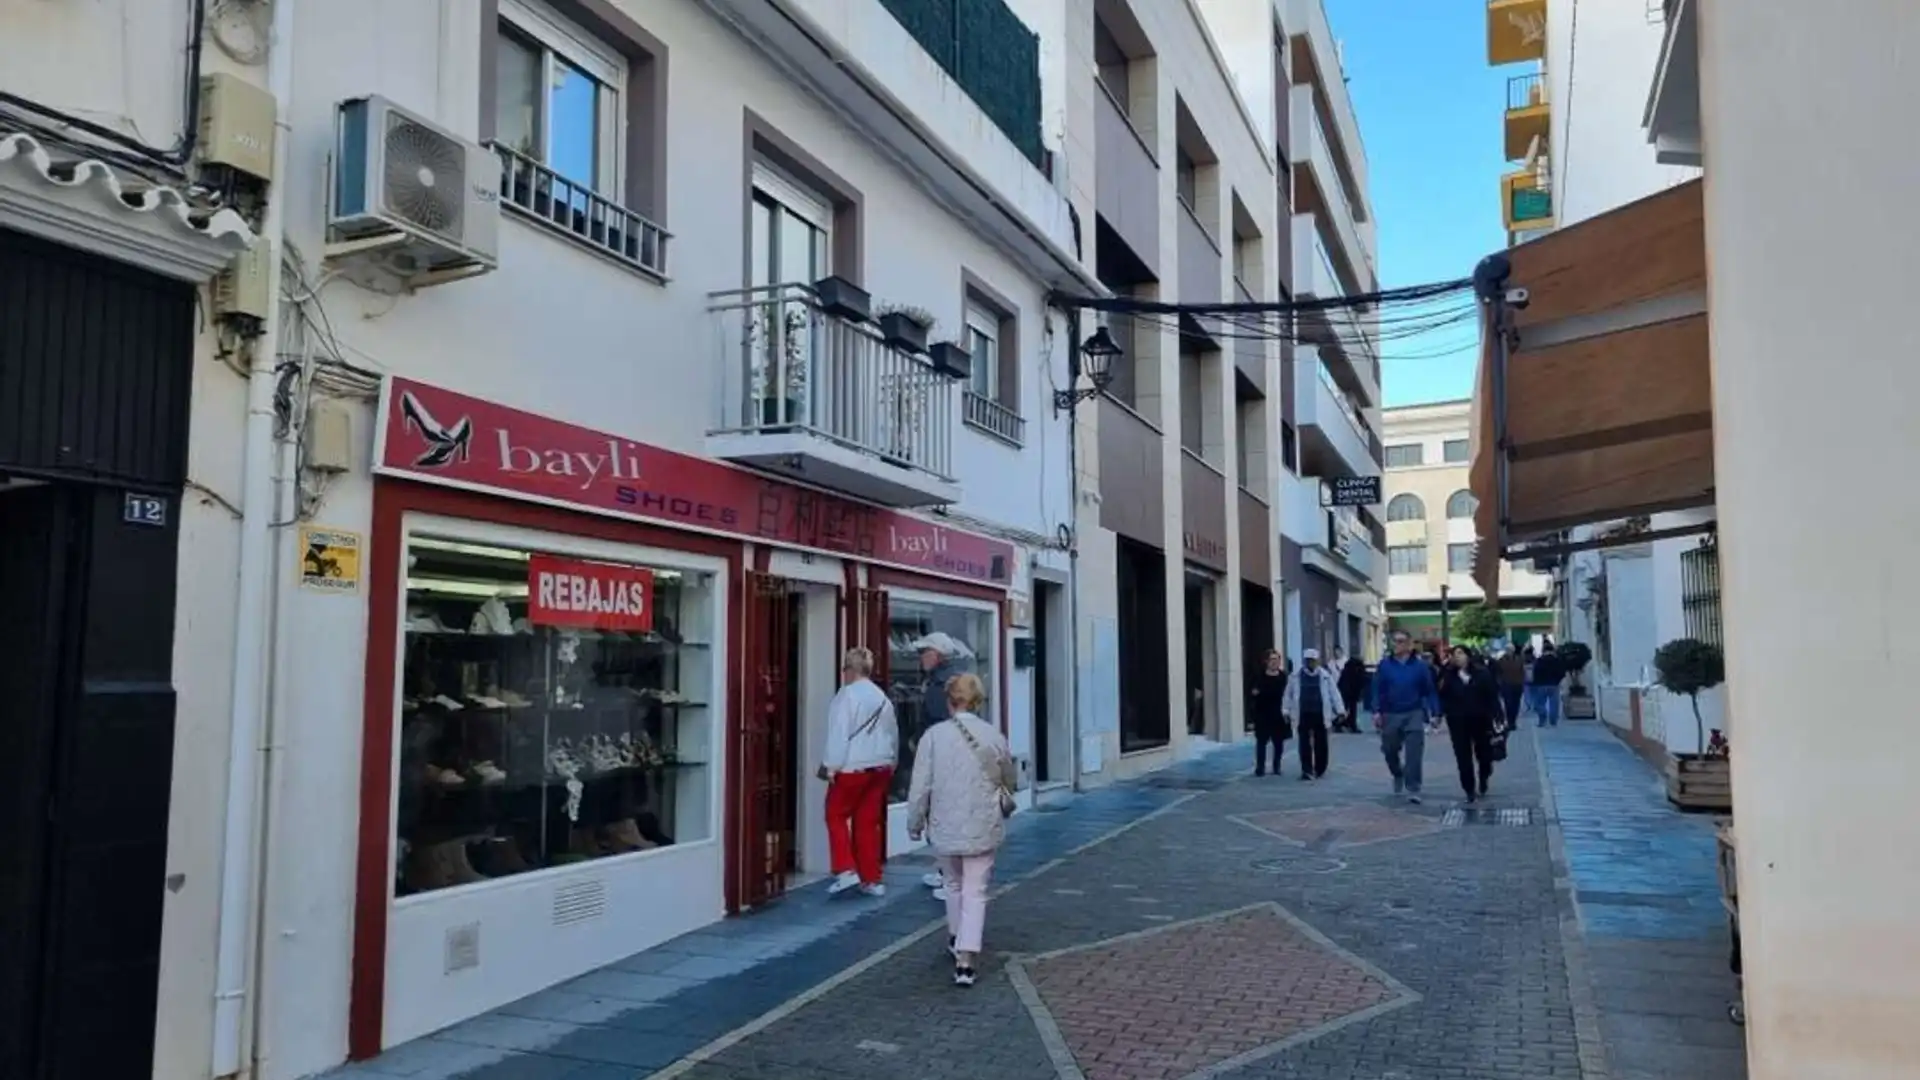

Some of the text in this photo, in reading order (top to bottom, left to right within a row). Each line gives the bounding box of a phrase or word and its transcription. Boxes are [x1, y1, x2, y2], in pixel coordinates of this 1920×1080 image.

[496, 428, 642, 490] bayli
[615, 486, 738, 525] SHOES
[1337, 487, 1376, 498] DENTAL
[131, 500, 161, 520] 12
[889, 525, 948, 560] bayli
[934, 554, 986, 578] SHOES
[302, 575, 356, 589] PROSEGUR
[538, 571, 643, 616] REBAJAS
